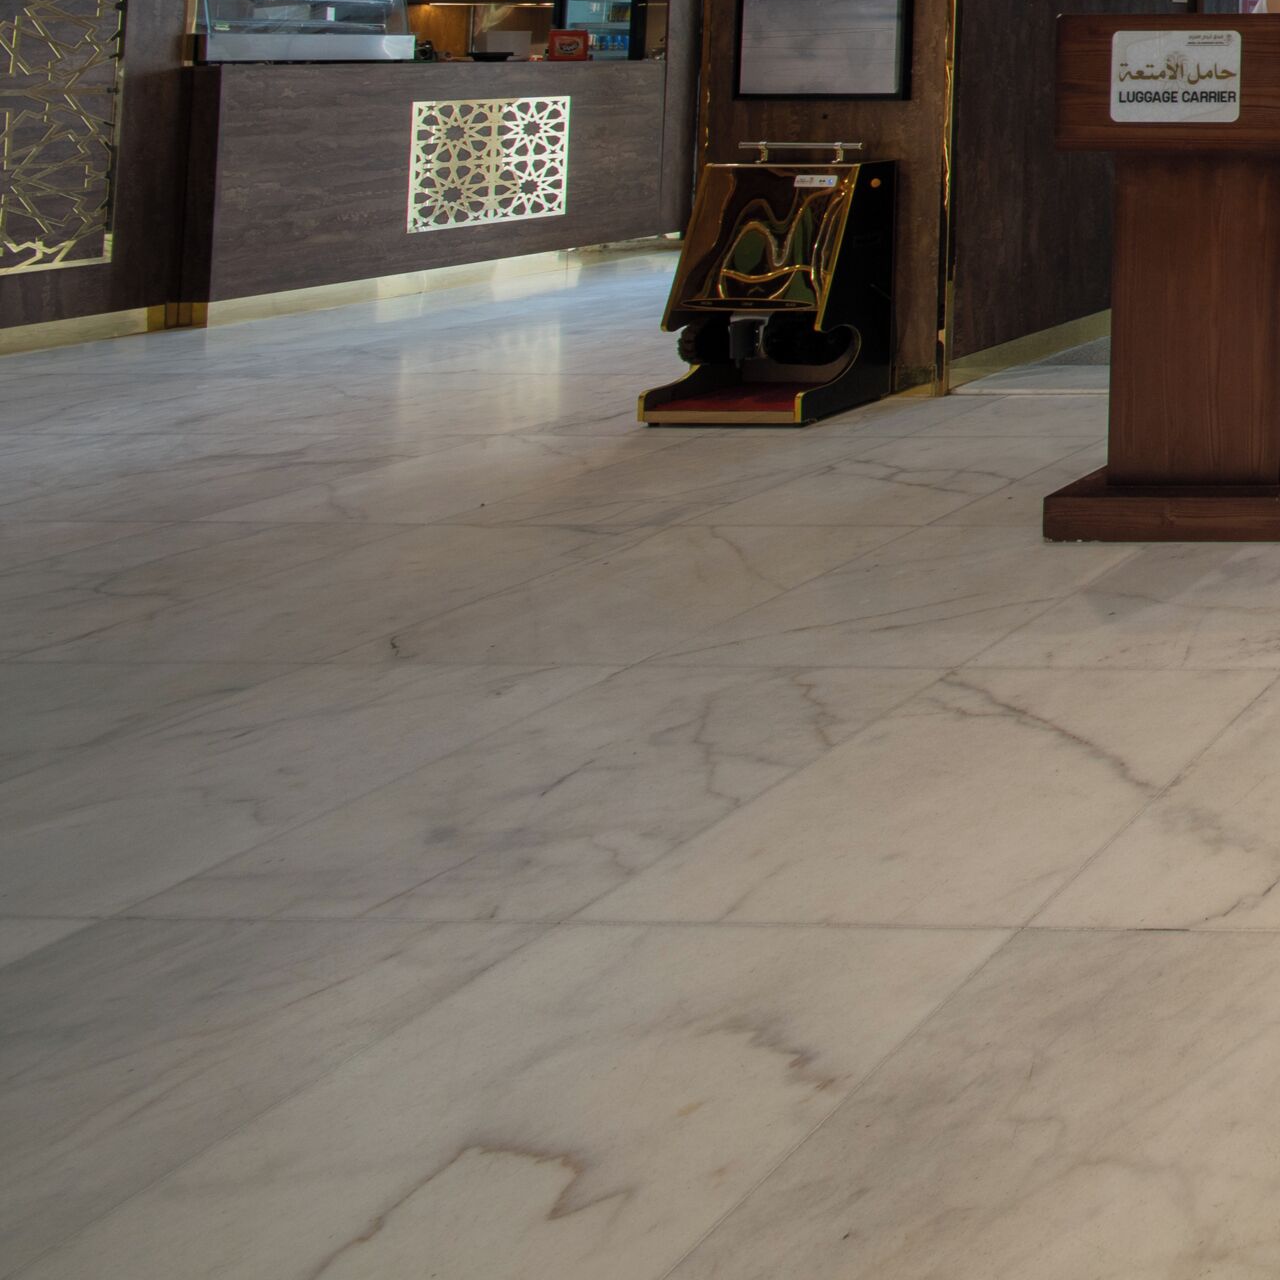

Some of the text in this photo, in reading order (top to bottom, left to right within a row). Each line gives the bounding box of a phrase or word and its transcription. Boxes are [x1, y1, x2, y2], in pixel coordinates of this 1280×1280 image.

[1118, 58, 1237, 85] حامل الأمتعة
[1118, 90, 1237, 103] LUGGAGE CARRIER
